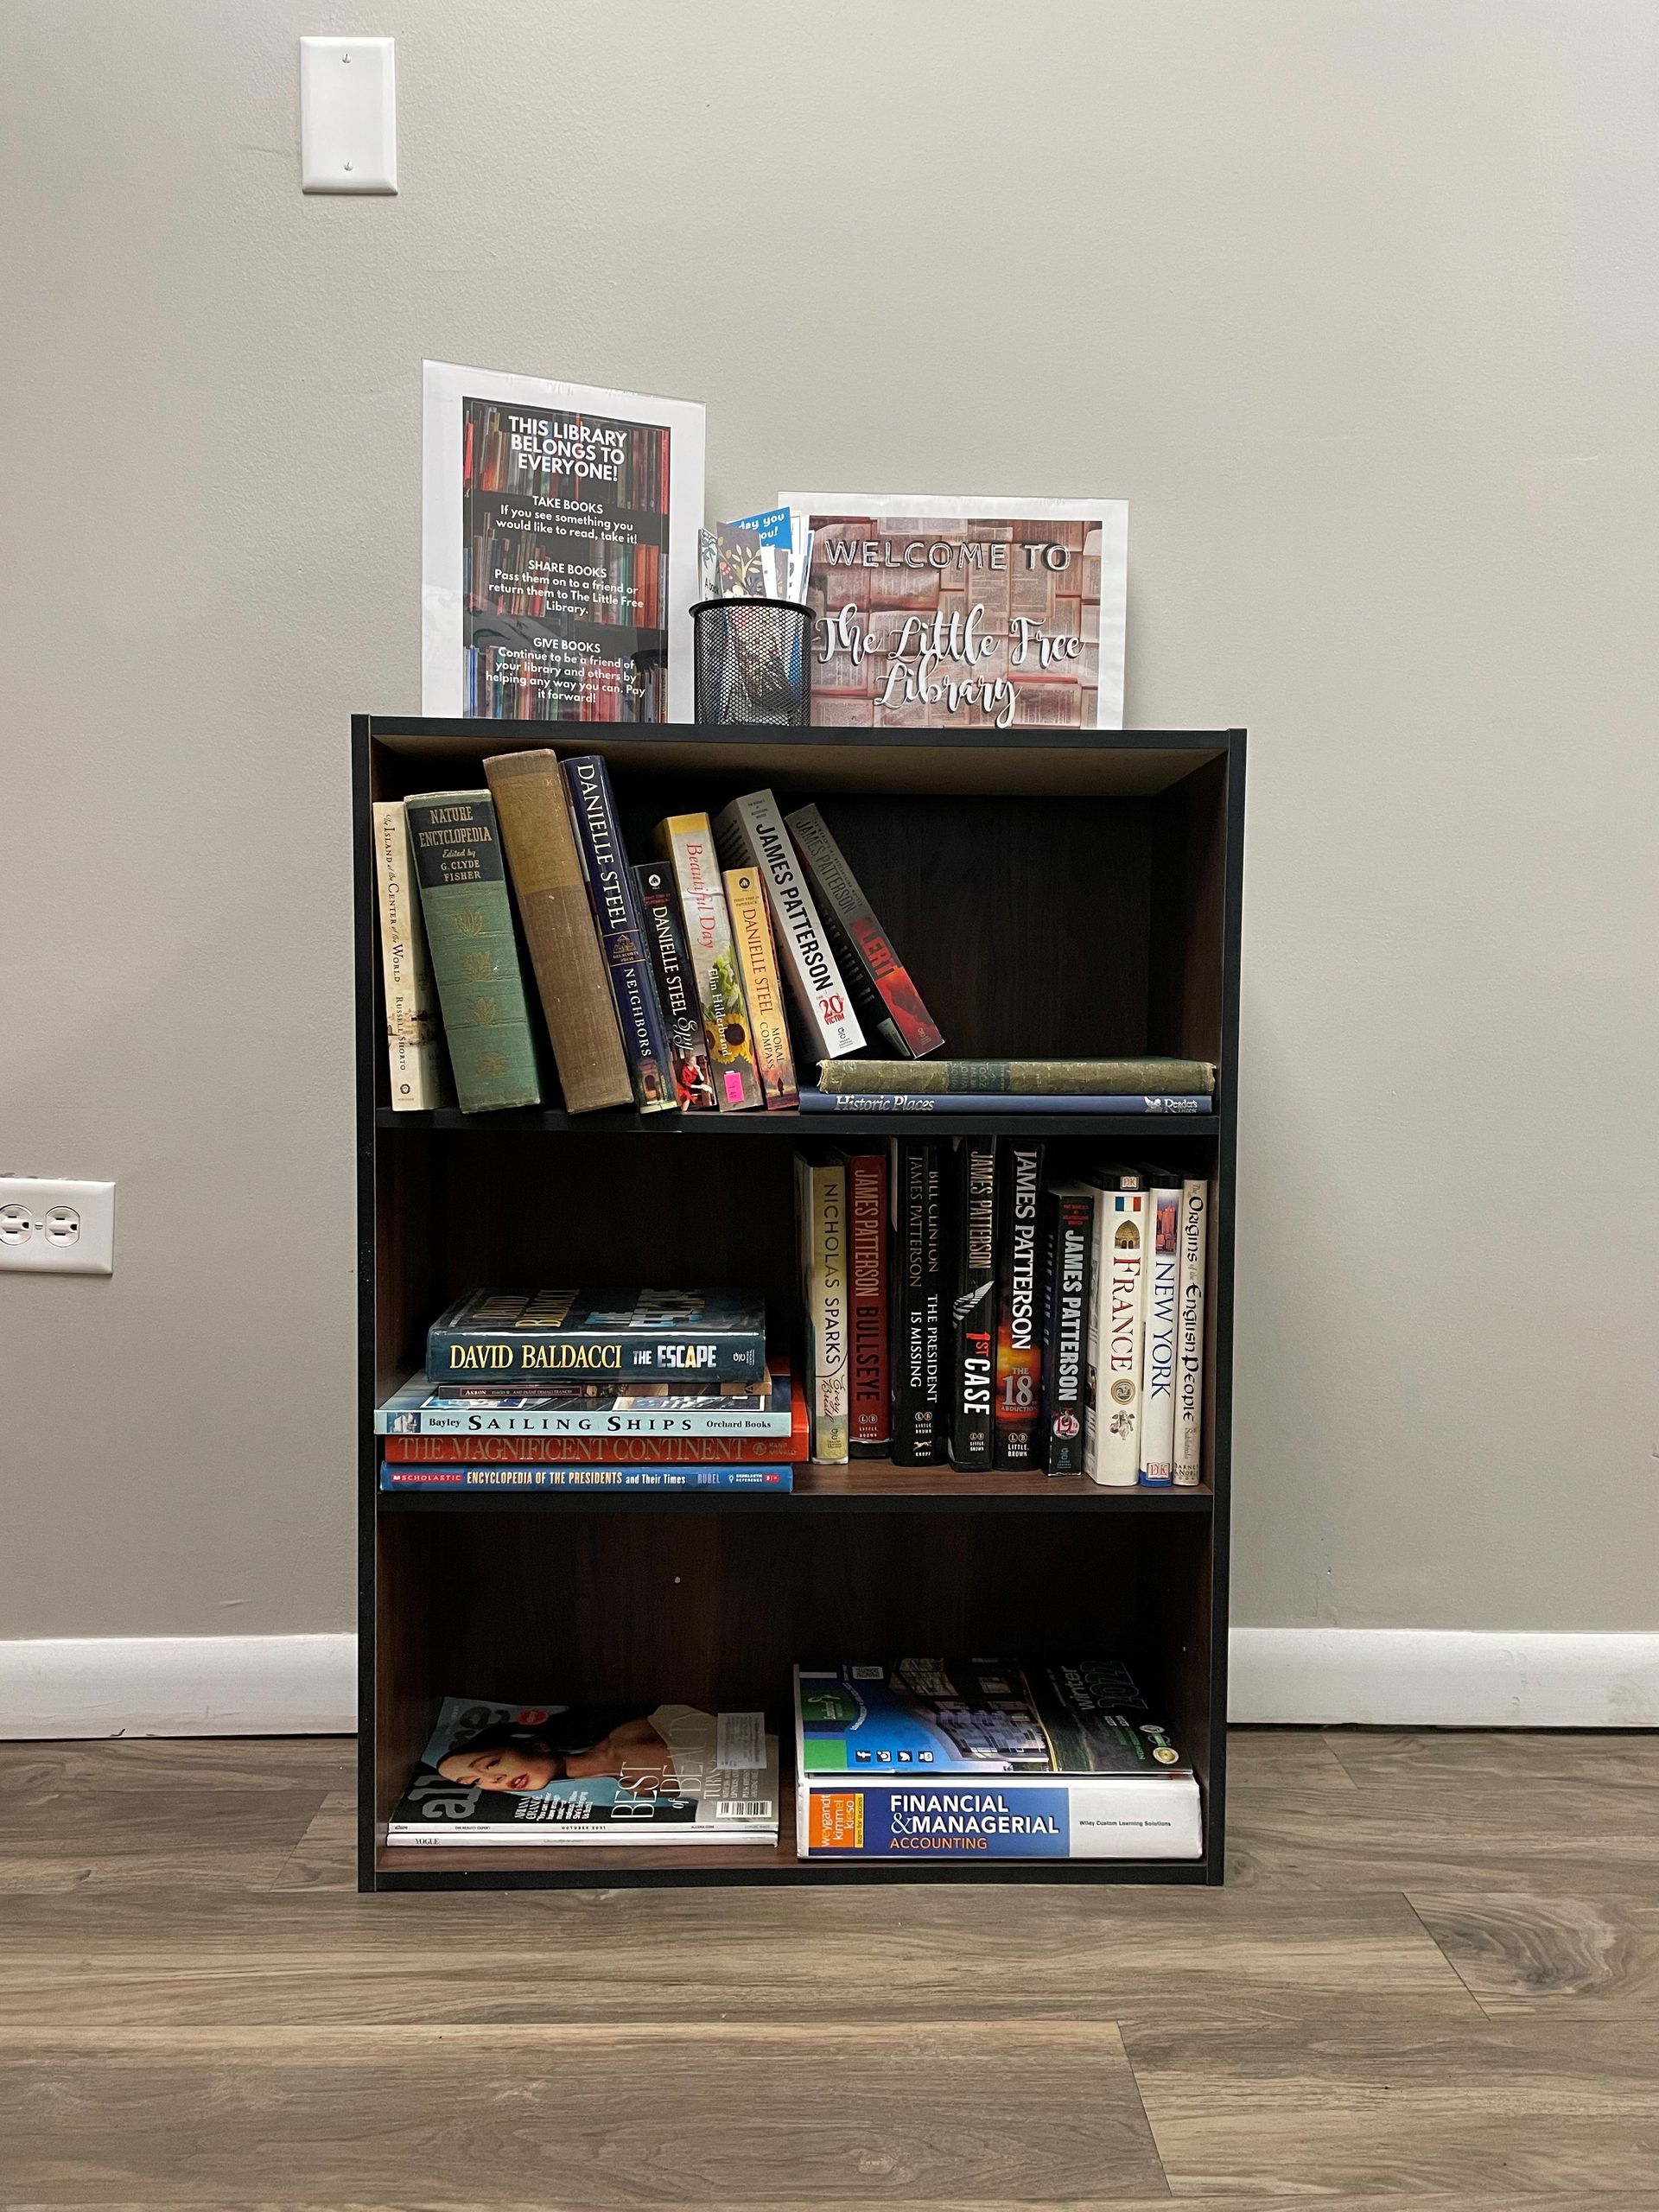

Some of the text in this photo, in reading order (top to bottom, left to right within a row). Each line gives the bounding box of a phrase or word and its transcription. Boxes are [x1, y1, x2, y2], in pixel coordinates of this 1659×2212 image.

[508, 416, 627, 448] THIS LIBRARY
[511, 434, 625, 465] BELONGS TO
[518, 453, 618, 482] EVERYONE!
[500, 505, 633, 532] If you see something you
[532, 495, 604, 514] TAKE BOOKS
[763, 513, 785, 527] you
[496, 519, 638, 544] would like to read, take it!
[528, 560, 607, 579] SHARE BOOKS
[824, 539, 1072, 571] WELCOME TO
[488, 583, 645, 608] return them to The Little Free
[494, 569, 639, 594] Pass them on to friend or
[546, 600, 589, 616] Library.
[533, 638, 601, 653] GIVE BOOKS
[815, 603, 1086, 669] The Little Free
[495, 661, 637, 684] your library and others by
[498, 646, 635, 670] Continue to be friend of
[486, 671, 645, 697] helping any way you can. Pay
[548, 689, 596, 703] forward!
[873, 654, 1022, 730] Library
[430, 806, 474, 824] NATURE
[418, 826, 493, 848] ENCYCLOPEDIA
[442, 849, 476, 858] Edited by
[576, 764, 614, 865] DANIELLE
[600, 870, 628, 929] STEEL
[443, 870, 481, 881] FISHER
[451, 860, 480, 870] CLYDE
[796, 821, 823, 858] JAMES
[815, 854, 857, 915] PATTERSON
[385, 827, 404, 982] ISLAND CENTER WORLD
[687, 843, 716, 949] Beautiful Day
[755, 823, 794, 886] JAMES
[779, 887, 834, 992] PATTERSON
[742, 908, 767, 974] DANIELLE
[652, 906, 680, 974] DANIELLE
[666, 976, 687, 1016] STEEL
[624, 968, 652, 1057] NEIGHBORS
[708, 968, 732, 1058] Elin Hilderbrand
[754, 977, 773, 1016] STEEL
[397, 1037, 406, 1071] SHORTO
[760, 1021, 776, 1070] COMPASS
[772, 1027, 785, 1062] MORAL
[834, 1094, 935, 1112] Historic Places
[854, 1169, 878, 1216] JAMES
[969, 1151, 994, 1269] JAMES PATTERSON
[855, 1220, 880, 1297] PATTERSON
[1011, 1150, 1038, 1350] JAMES PATTERSON
[1063, 1230, 1084, 1293] JAMES
[823, 1184, 841, 1364] NICHOLAS SPARKS
[908, 1156, 923, 1388] JAMES PATTERSON IS MISSING
[926, 1171, 939, 1404] BILL CLINTON THE PRESIDENT
[1110, 1256, 1141, 1371] FRANCE
[1151, 1262, 1176, 1399] NEW YORK
[449, 1344, 513, 1370] DAVID
[521, 1344, 622, 1370] BALDACCI
[632, 1350, 652, 1365] THE
[657, 1344, 717, 1369] ESCAPE
[855, 1306, 880, 1402] BULLSEYE
[1058, 1297, 1082, 1401] PATTERSON
[963, 1357, 991, 1415] CASE
[429, 1414, 772, 1432] Bayley SAILING SHIPS Orchard Books
[397, 1437, 444, 1460] THE
[450, 1437, 608, 1460] MAGNIFICENT
[613, 1437, 747, 1460] CONTINENT
[467, 1471, 532, 1484] ENCYCLOPEDIA
[535, 1471, 546, 1484] OF
[550, 1471, 566, 1484] THE
[569, 1471, 622, 1484] PRESIDENTS
[625, 1474, 639, 1484] and
[641, 1473, 661, 1484] Their
[663, 1473, 686, 1484] Times
[697, 1473, 720, 1484] RUBEL
[1061, 1665, 1096, 1710] winter
[610, 1761, 662, 1819] BEST
[890, 1795, 1009, 1813] FINANCIAL
[821, 1794, 833, 1848] weygandt
[833, 1800, 844, 1840] kimmel
[843, 1800, 855, 1829] kieso
[889, 1837, 988, 1850] ACCOUNTING
